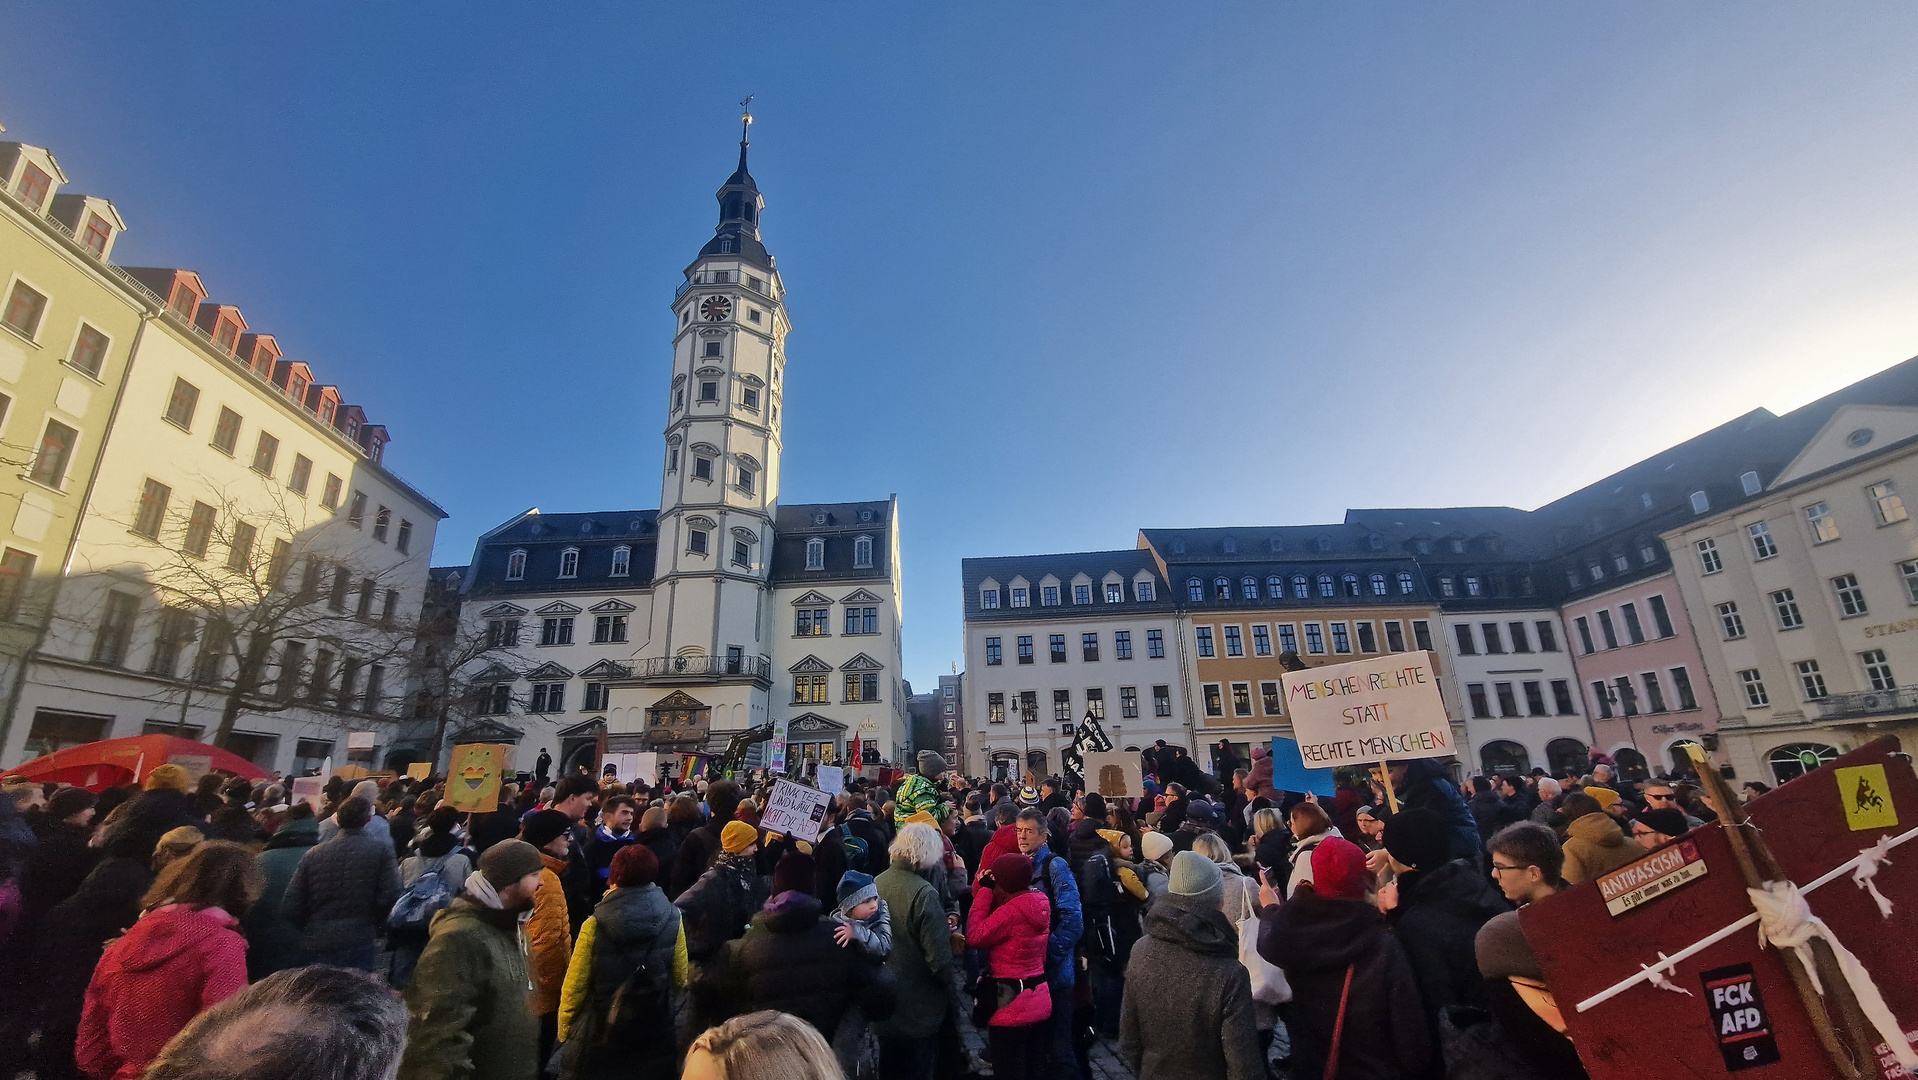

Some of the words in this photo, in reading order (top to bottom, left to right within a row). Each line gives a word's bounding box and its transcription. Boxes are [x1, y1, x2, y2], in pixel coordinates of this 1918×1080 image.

[1290, 667, 1426, 702] MENSCHENRECHTE
[1342, 702, 1390, 726] STATT
[1302, 741, 1356, 762] RECHTE
[1359, 731, 1446, 756] MENSCHEN
[772, 794, 791, 808] UND
[790, 800, 811, 814] WAHL
[775, 781, 800, 799] TRINK
[801, 790, 821, 804] TEE
[781, 813, 798, 829] DIE
[797, 818, 818, 835] AFD
[1601, 848, 1685, 899] ANTIFASCISM
[1621, 895, 1632, 907] Es
[1713, 982, 1754, 1009] FCK
[1722, 1007, 1761, 1035] AFD
